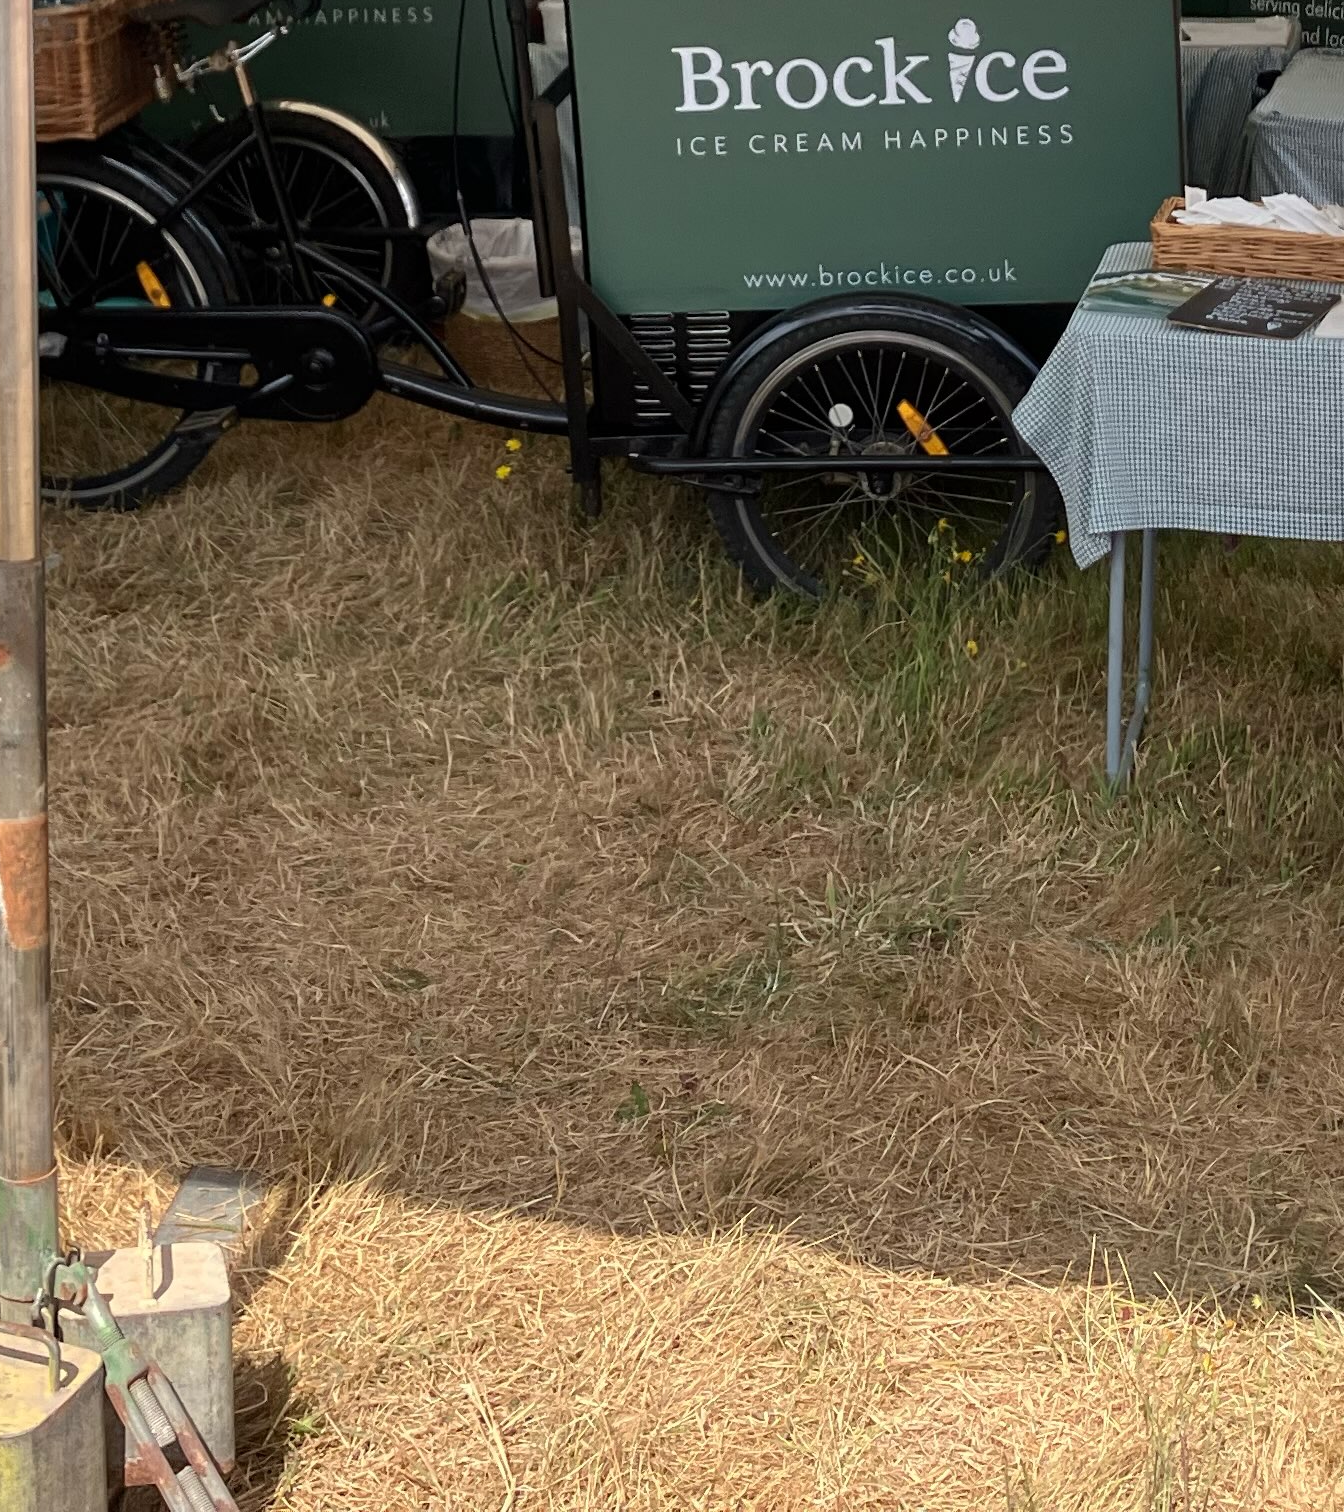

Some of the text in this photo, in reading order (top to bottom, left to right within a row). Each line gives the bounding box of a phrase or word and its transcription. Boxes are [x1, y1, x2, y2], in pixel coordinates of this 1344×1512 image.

[314, 6, 434, 25] APPINESS
[1302, 26, 1322, 45] nd
[670, 17, 1070, 113] Brock ice
[675, 124, 1076, 157] ICE CREAM HAPPINESS
[742, 259, 1018, 290] www.brockice.co.uk
